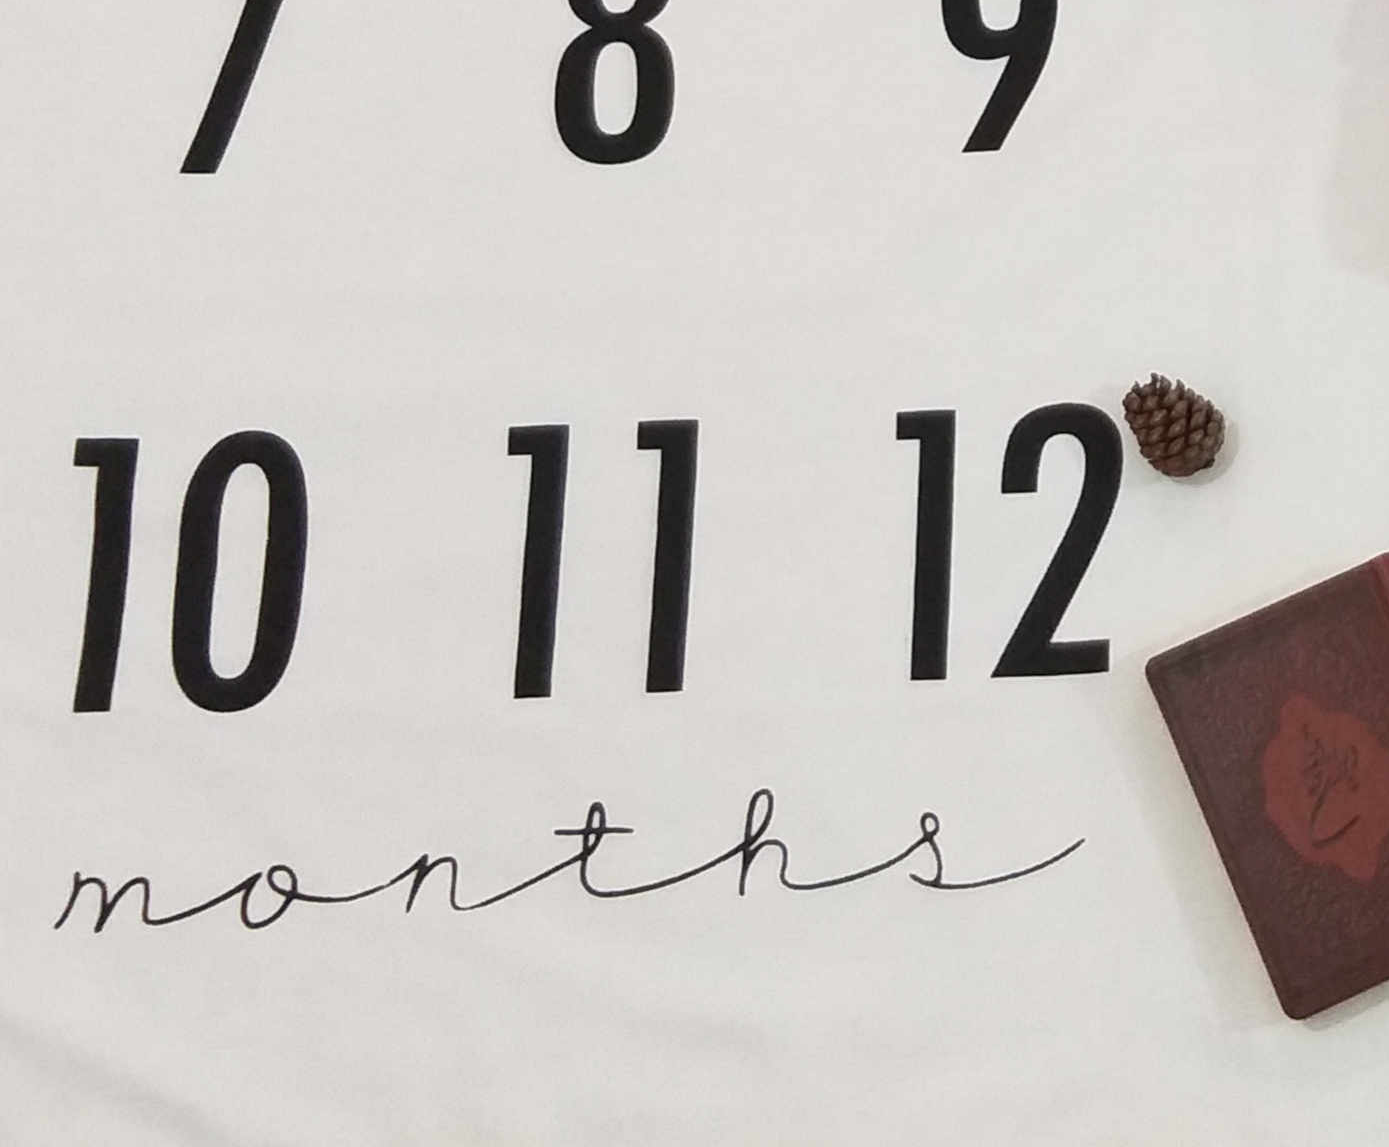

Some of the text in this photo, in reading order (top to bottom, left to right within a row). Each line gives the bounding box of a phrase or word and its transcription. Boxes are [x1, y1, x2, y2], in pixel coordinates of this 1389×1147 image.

[74, 403, 1123, 713] 10 11 12
[55, 789, 1084, 932] months
